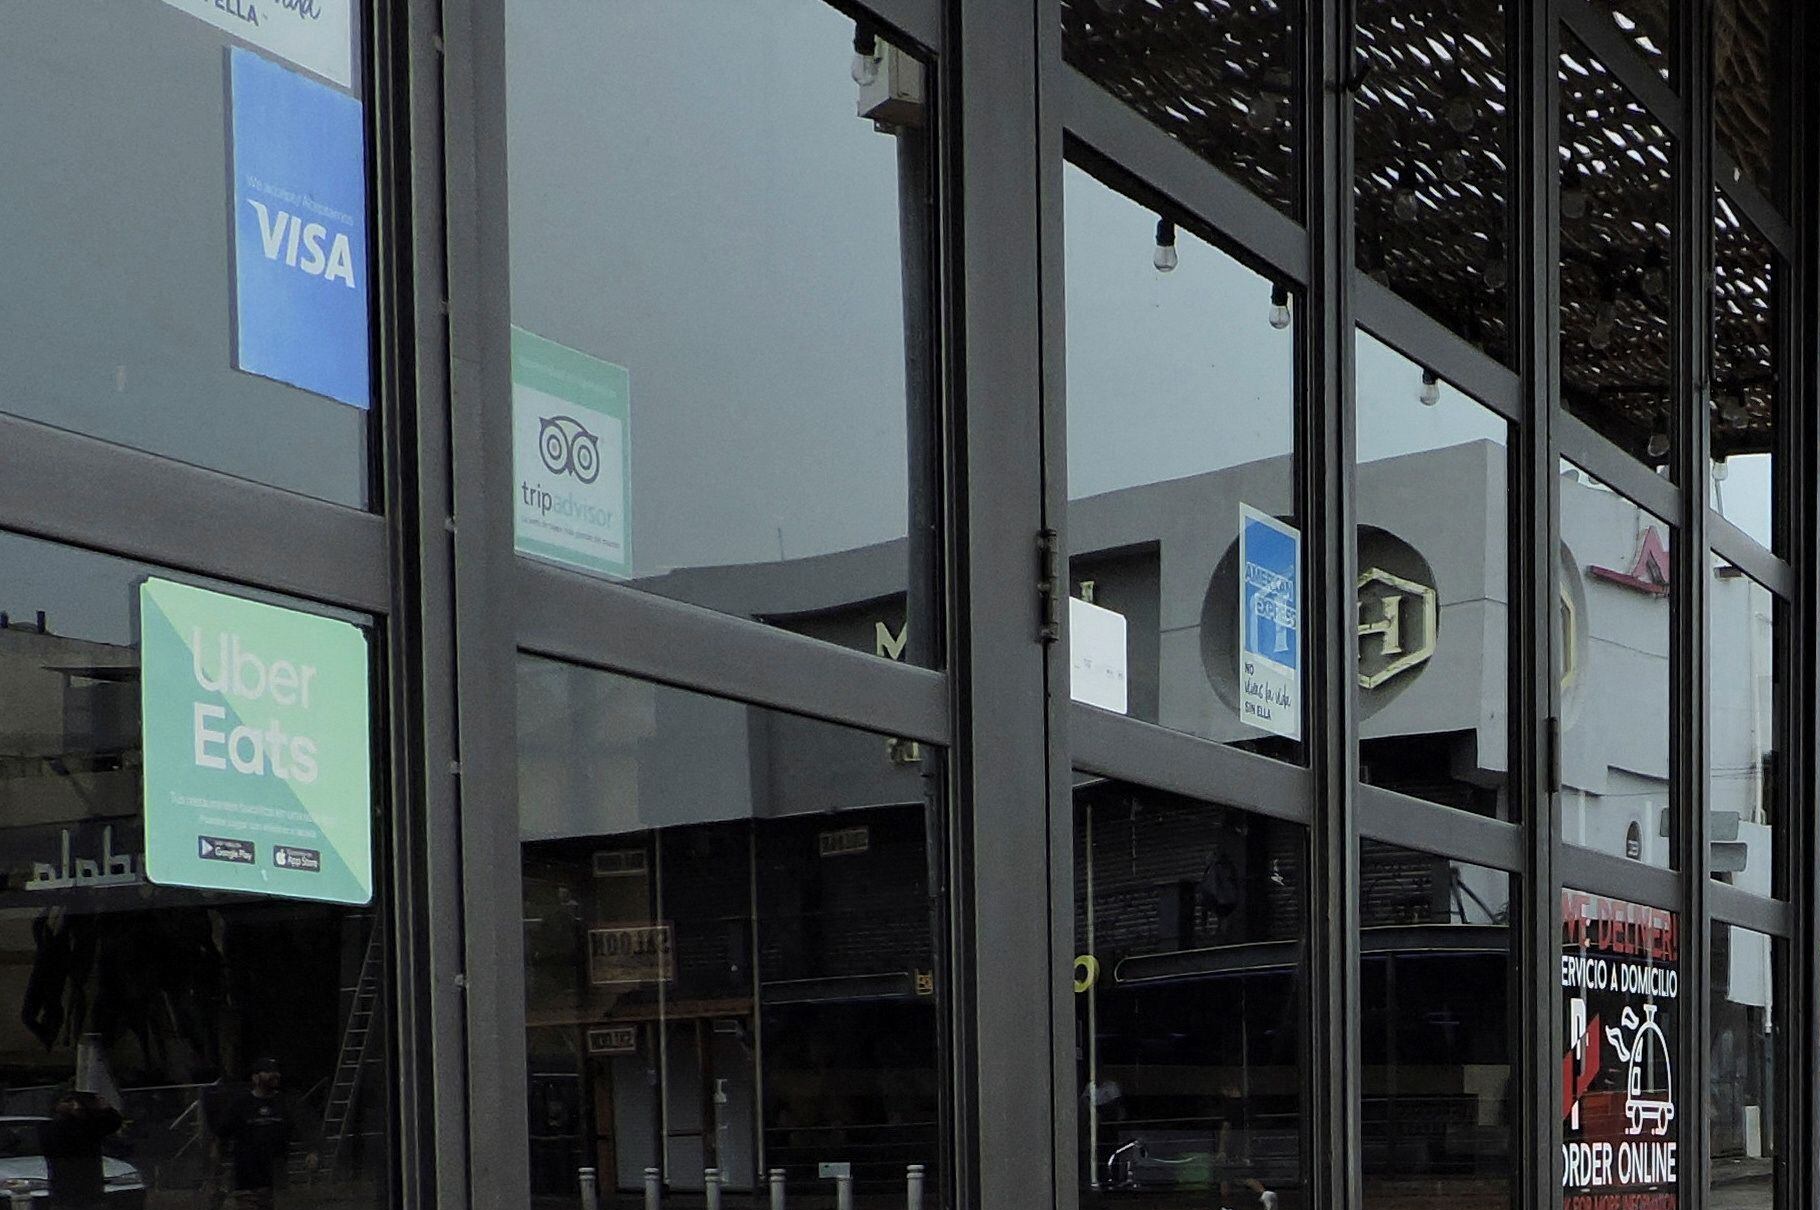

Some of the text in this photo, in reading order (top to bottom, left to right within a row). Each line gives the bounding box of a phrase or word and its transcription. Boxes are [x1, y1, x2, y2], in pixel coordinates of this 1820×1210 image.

[247, 198, 356, 289] VISA
[521, 480, 614, 528] tripadvisor
[191, 625, 318, 709] Uber
[1244, 661, 1255, 676] NO
[1244, 701, 1272, 721] SIN ELLA
[194, 702, 319, 783] Eats
[1562, 955, 1678, 998] ERVICIO A DOMICILIO
[1618, 1141, 1677, 1184] ONLINE
